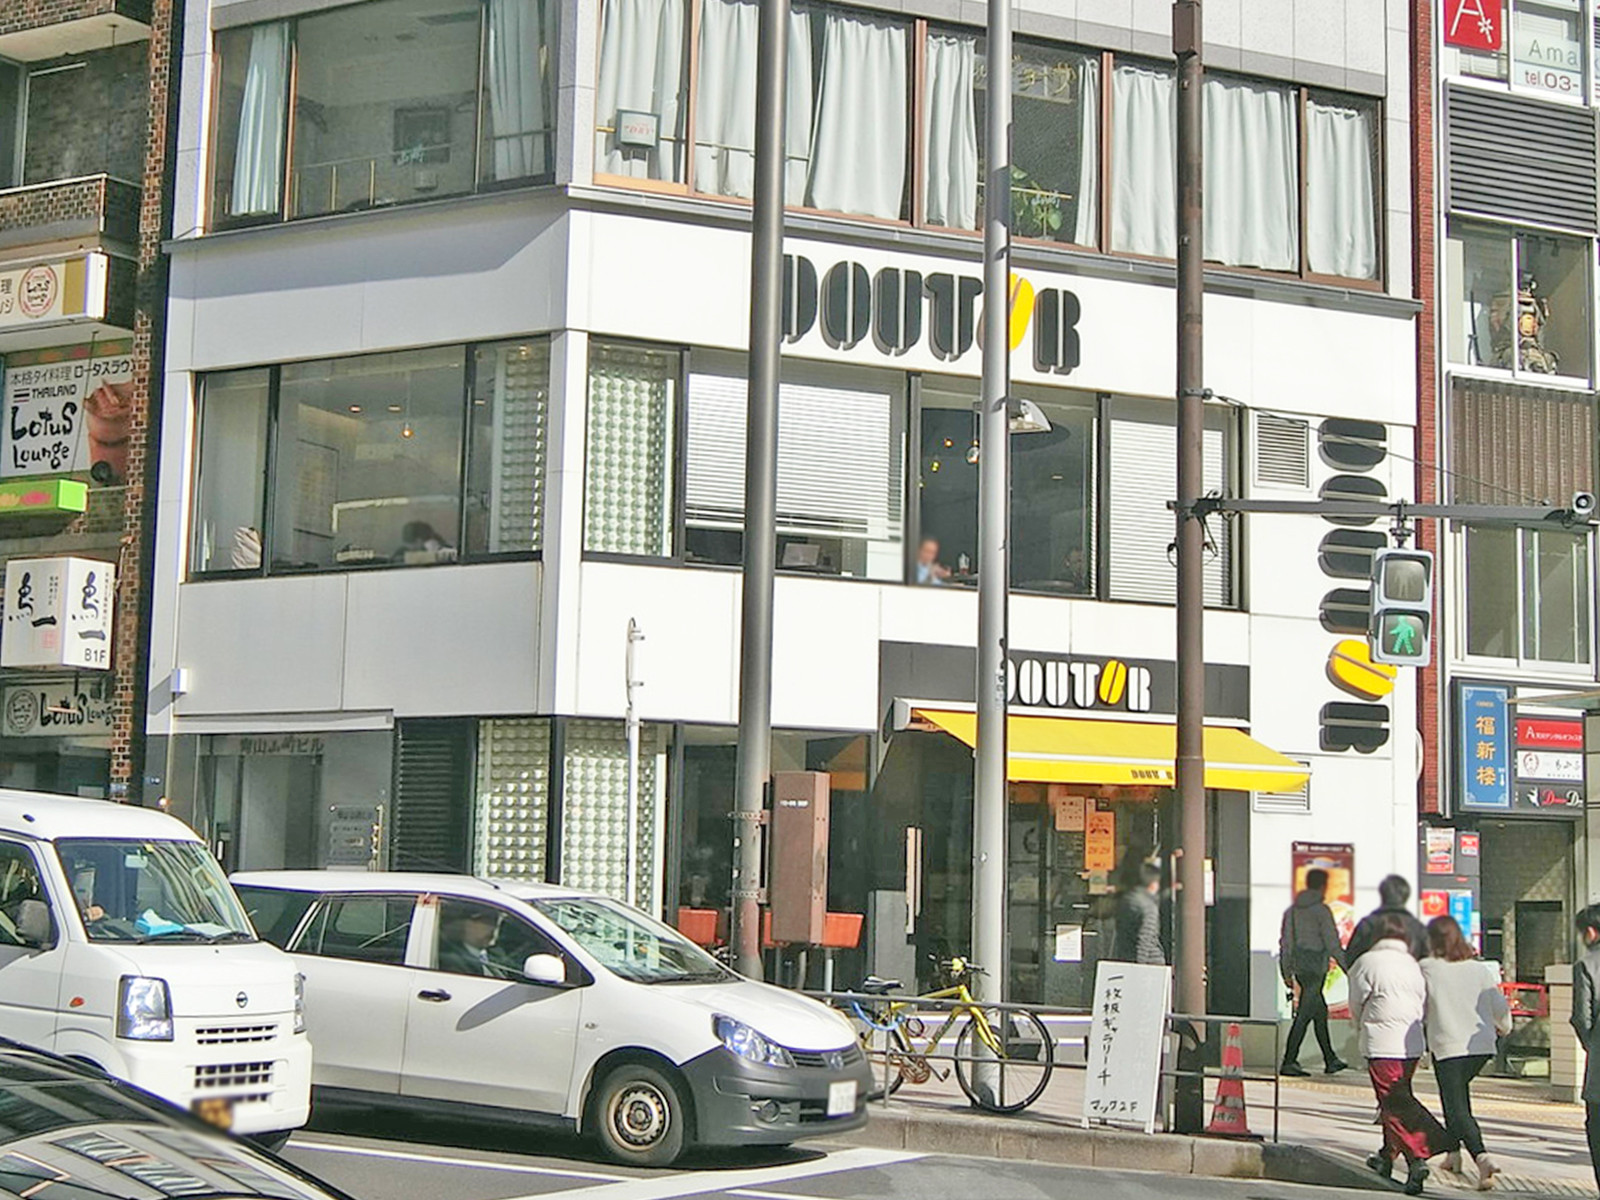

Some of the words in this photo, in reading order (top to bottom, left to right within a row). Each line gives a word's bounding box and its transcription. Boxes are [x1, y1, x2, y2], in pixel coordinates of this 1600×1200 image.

[1529, 40, 1578, 66] Ama
[32, 383, 77, 399] THAILAND
[13, 440, 70, 470] Lounge
[84, 648, 107, 663] B1F
